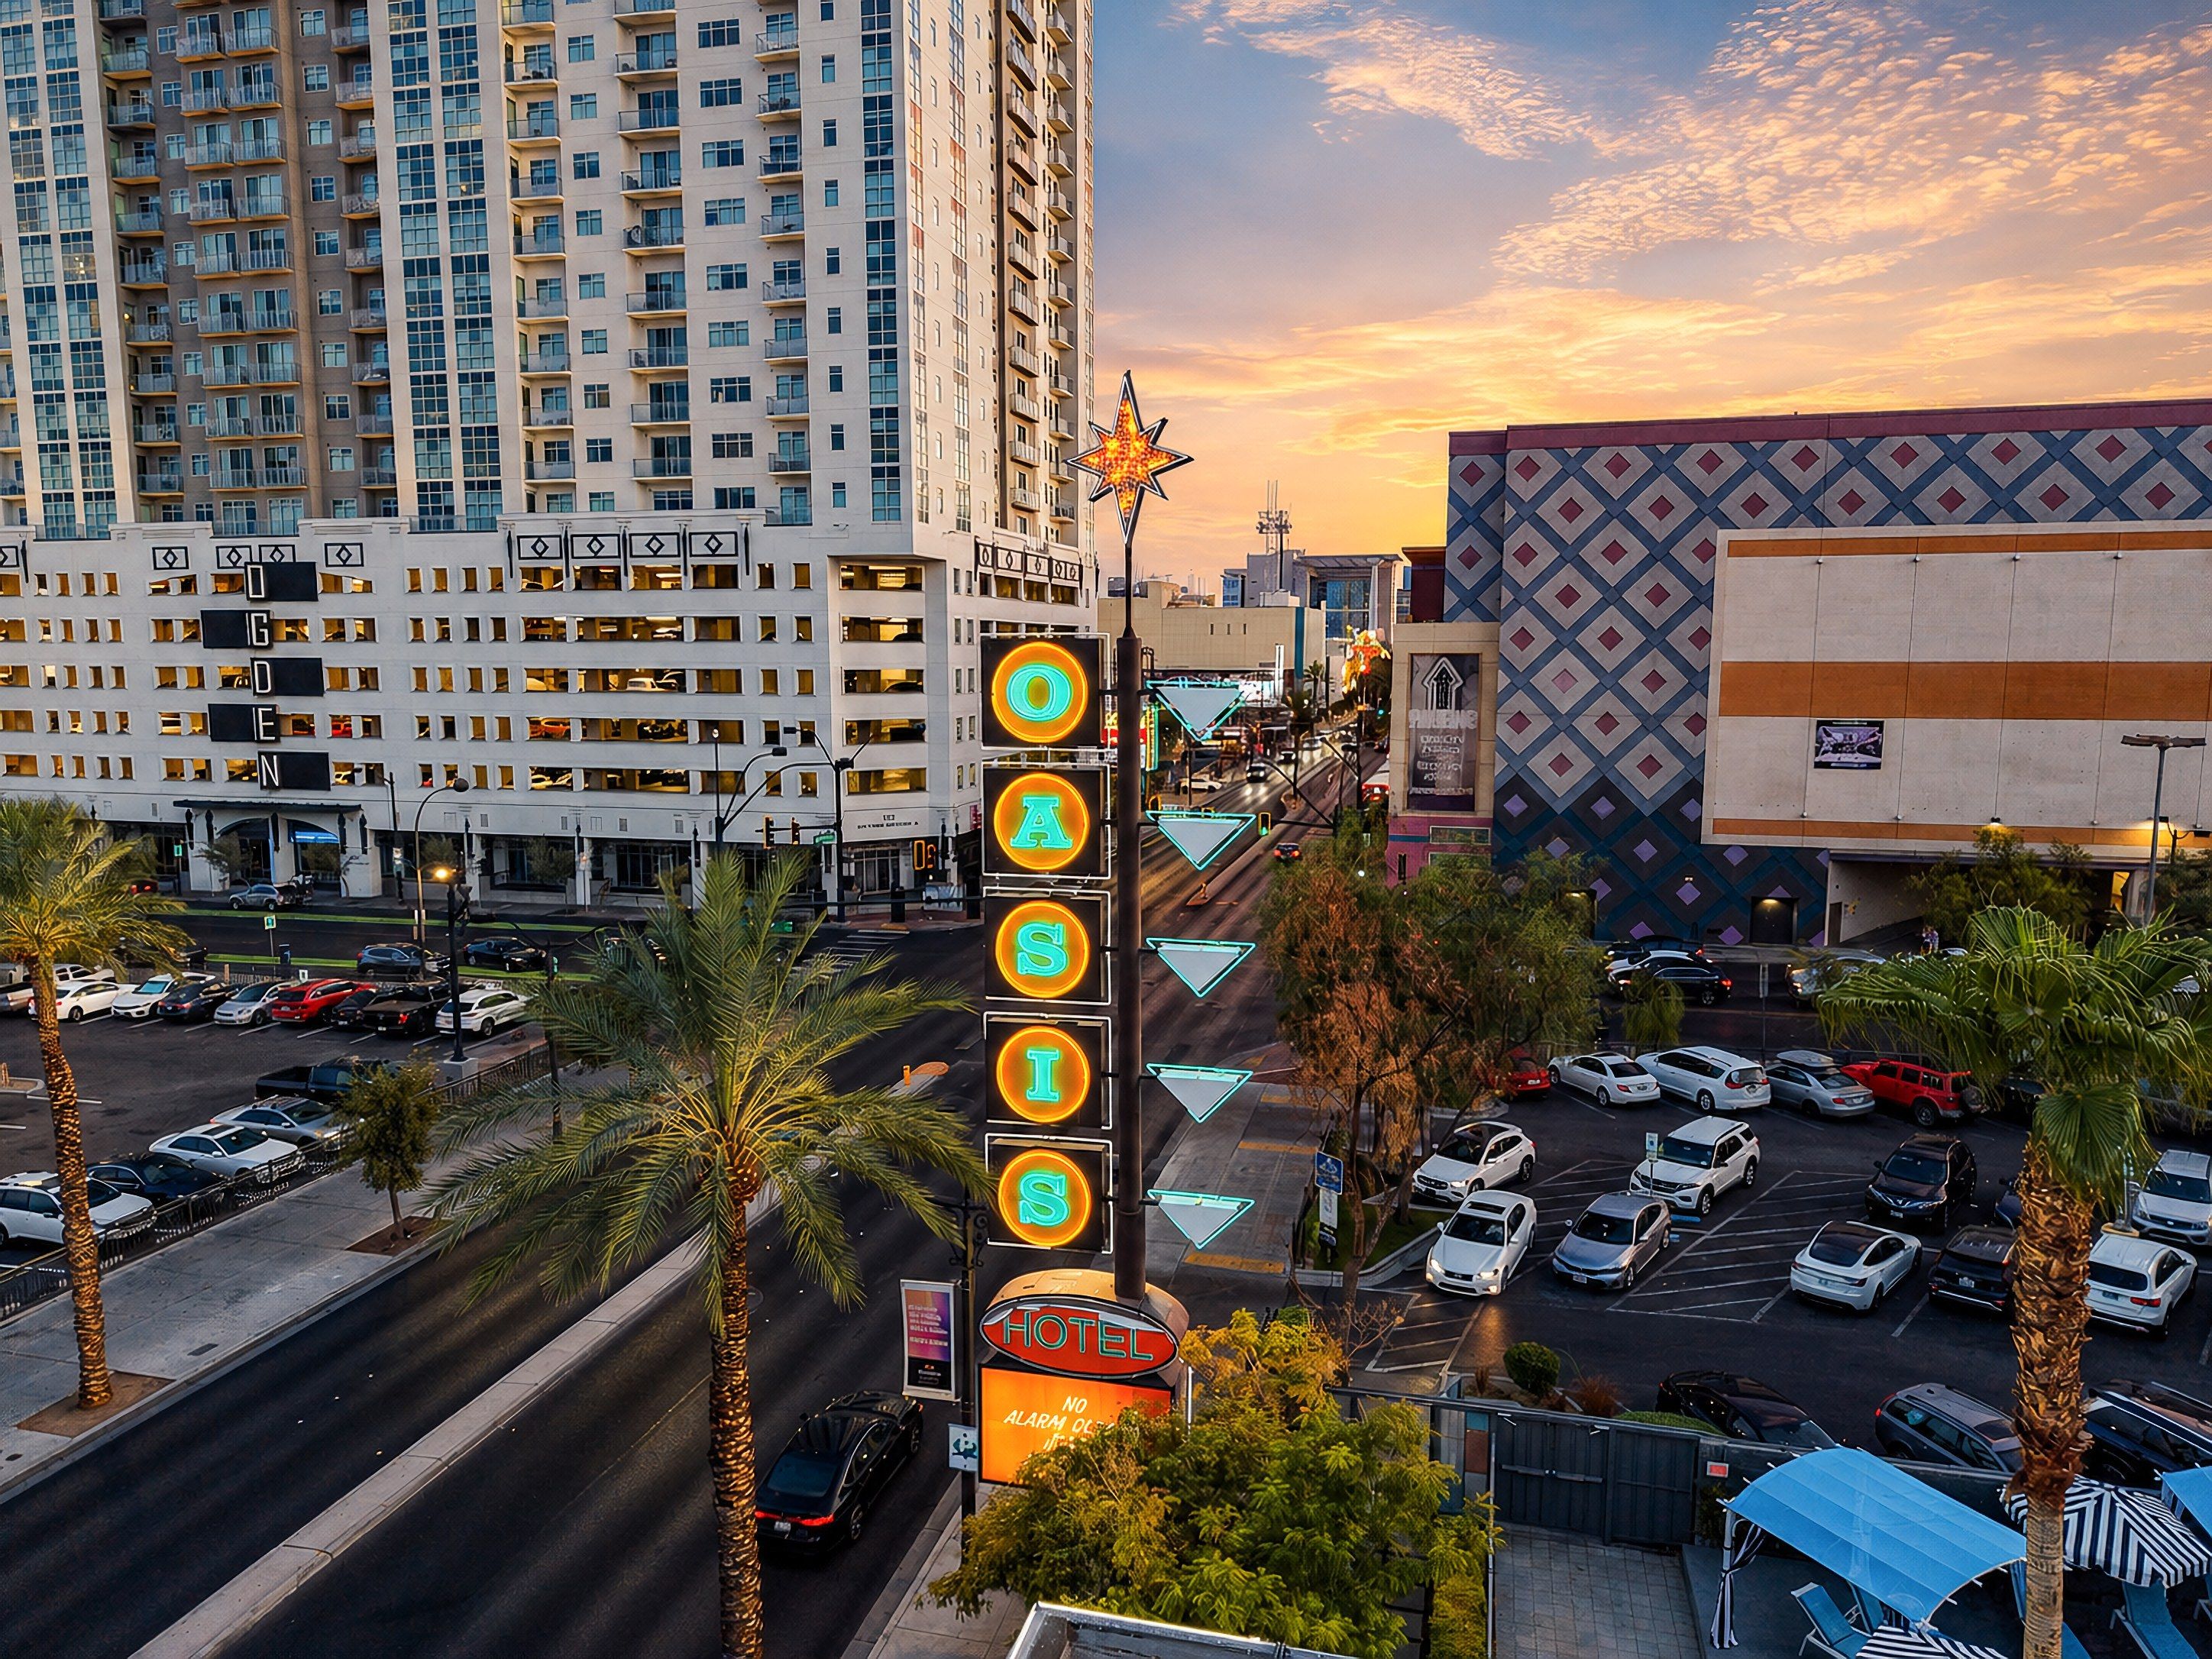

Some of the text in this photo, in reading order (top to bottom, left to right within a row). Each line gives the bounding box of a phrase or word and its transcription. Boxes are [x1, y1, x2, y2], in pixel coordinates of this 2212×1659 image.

[246, 564, 279, 787] OGDEN
[1005, 663, 1073, 1227] OASIS
[1002, 1307, 1154, 1362] HOTEL
[1003, 1409, 1068, 1431] ALARM
[1062, 1395, 1088, 1414] NO
